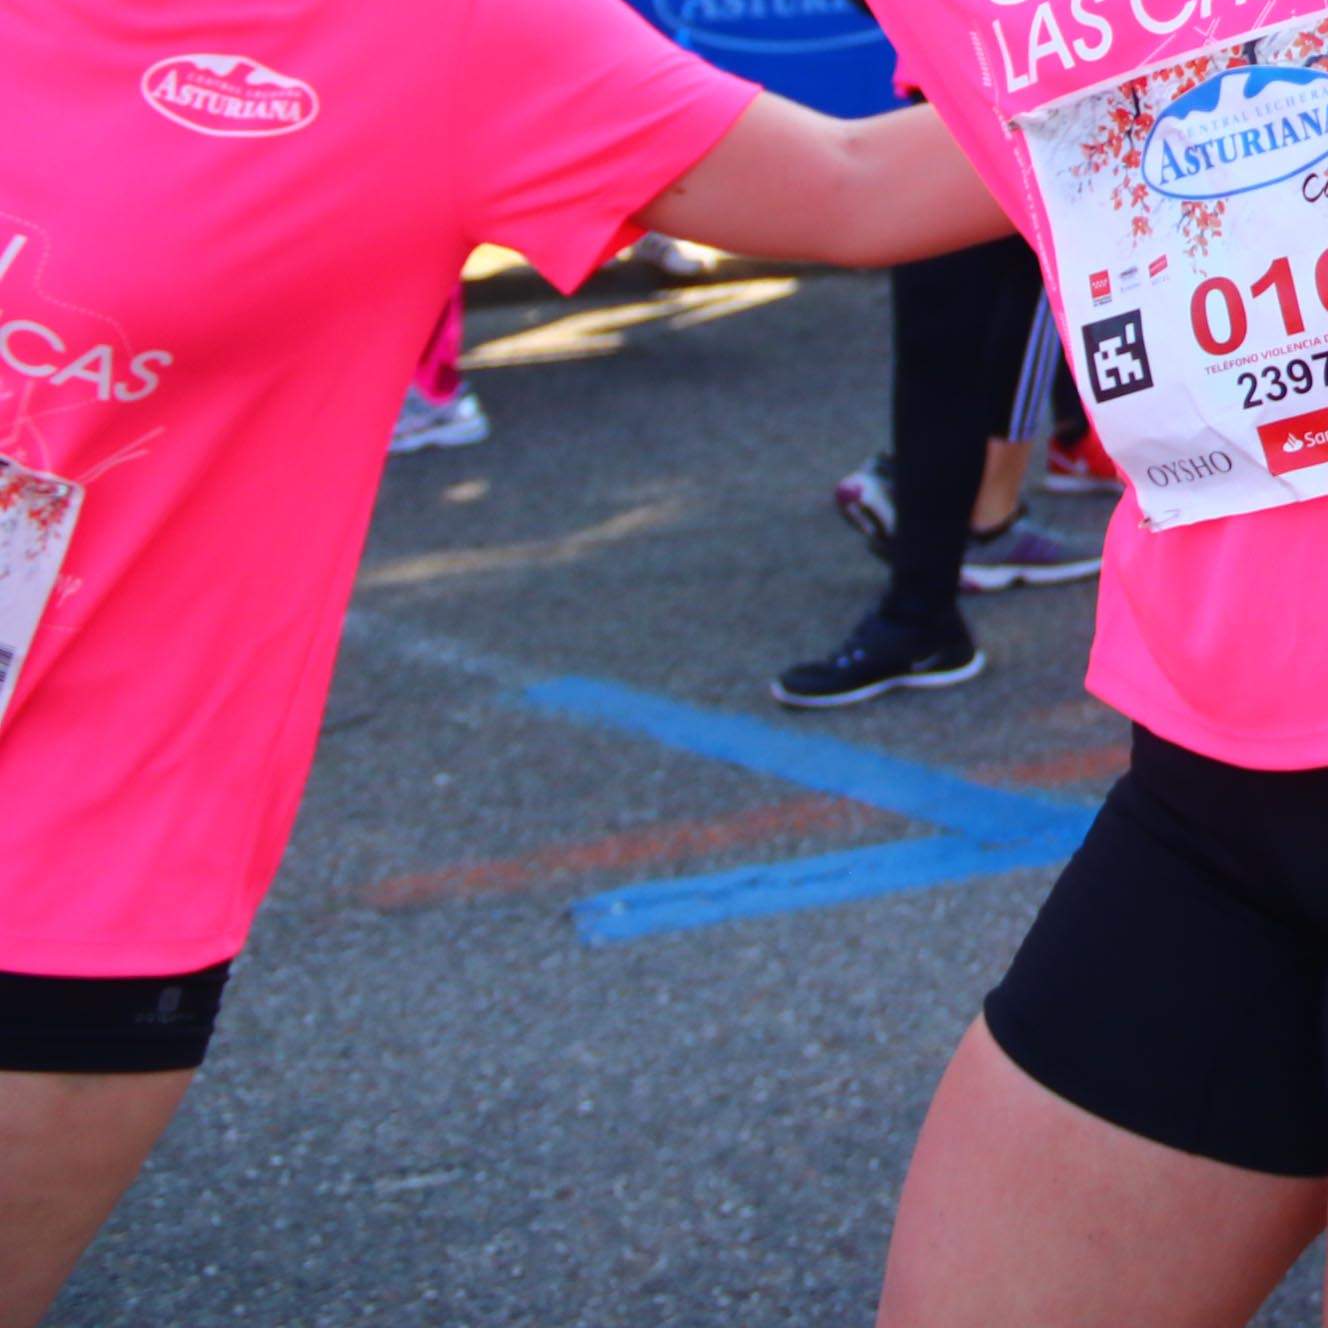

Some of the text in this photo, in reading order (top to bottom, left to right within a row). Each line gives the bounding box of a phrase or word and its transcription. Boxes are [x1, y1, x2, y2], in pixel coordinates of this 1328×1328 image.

[152, 70, 302, 122] ASTURIANA
[1261, 336, 1322, 360] VIOLENCIA
[1145, 449, 1234, 488] OYSHO
